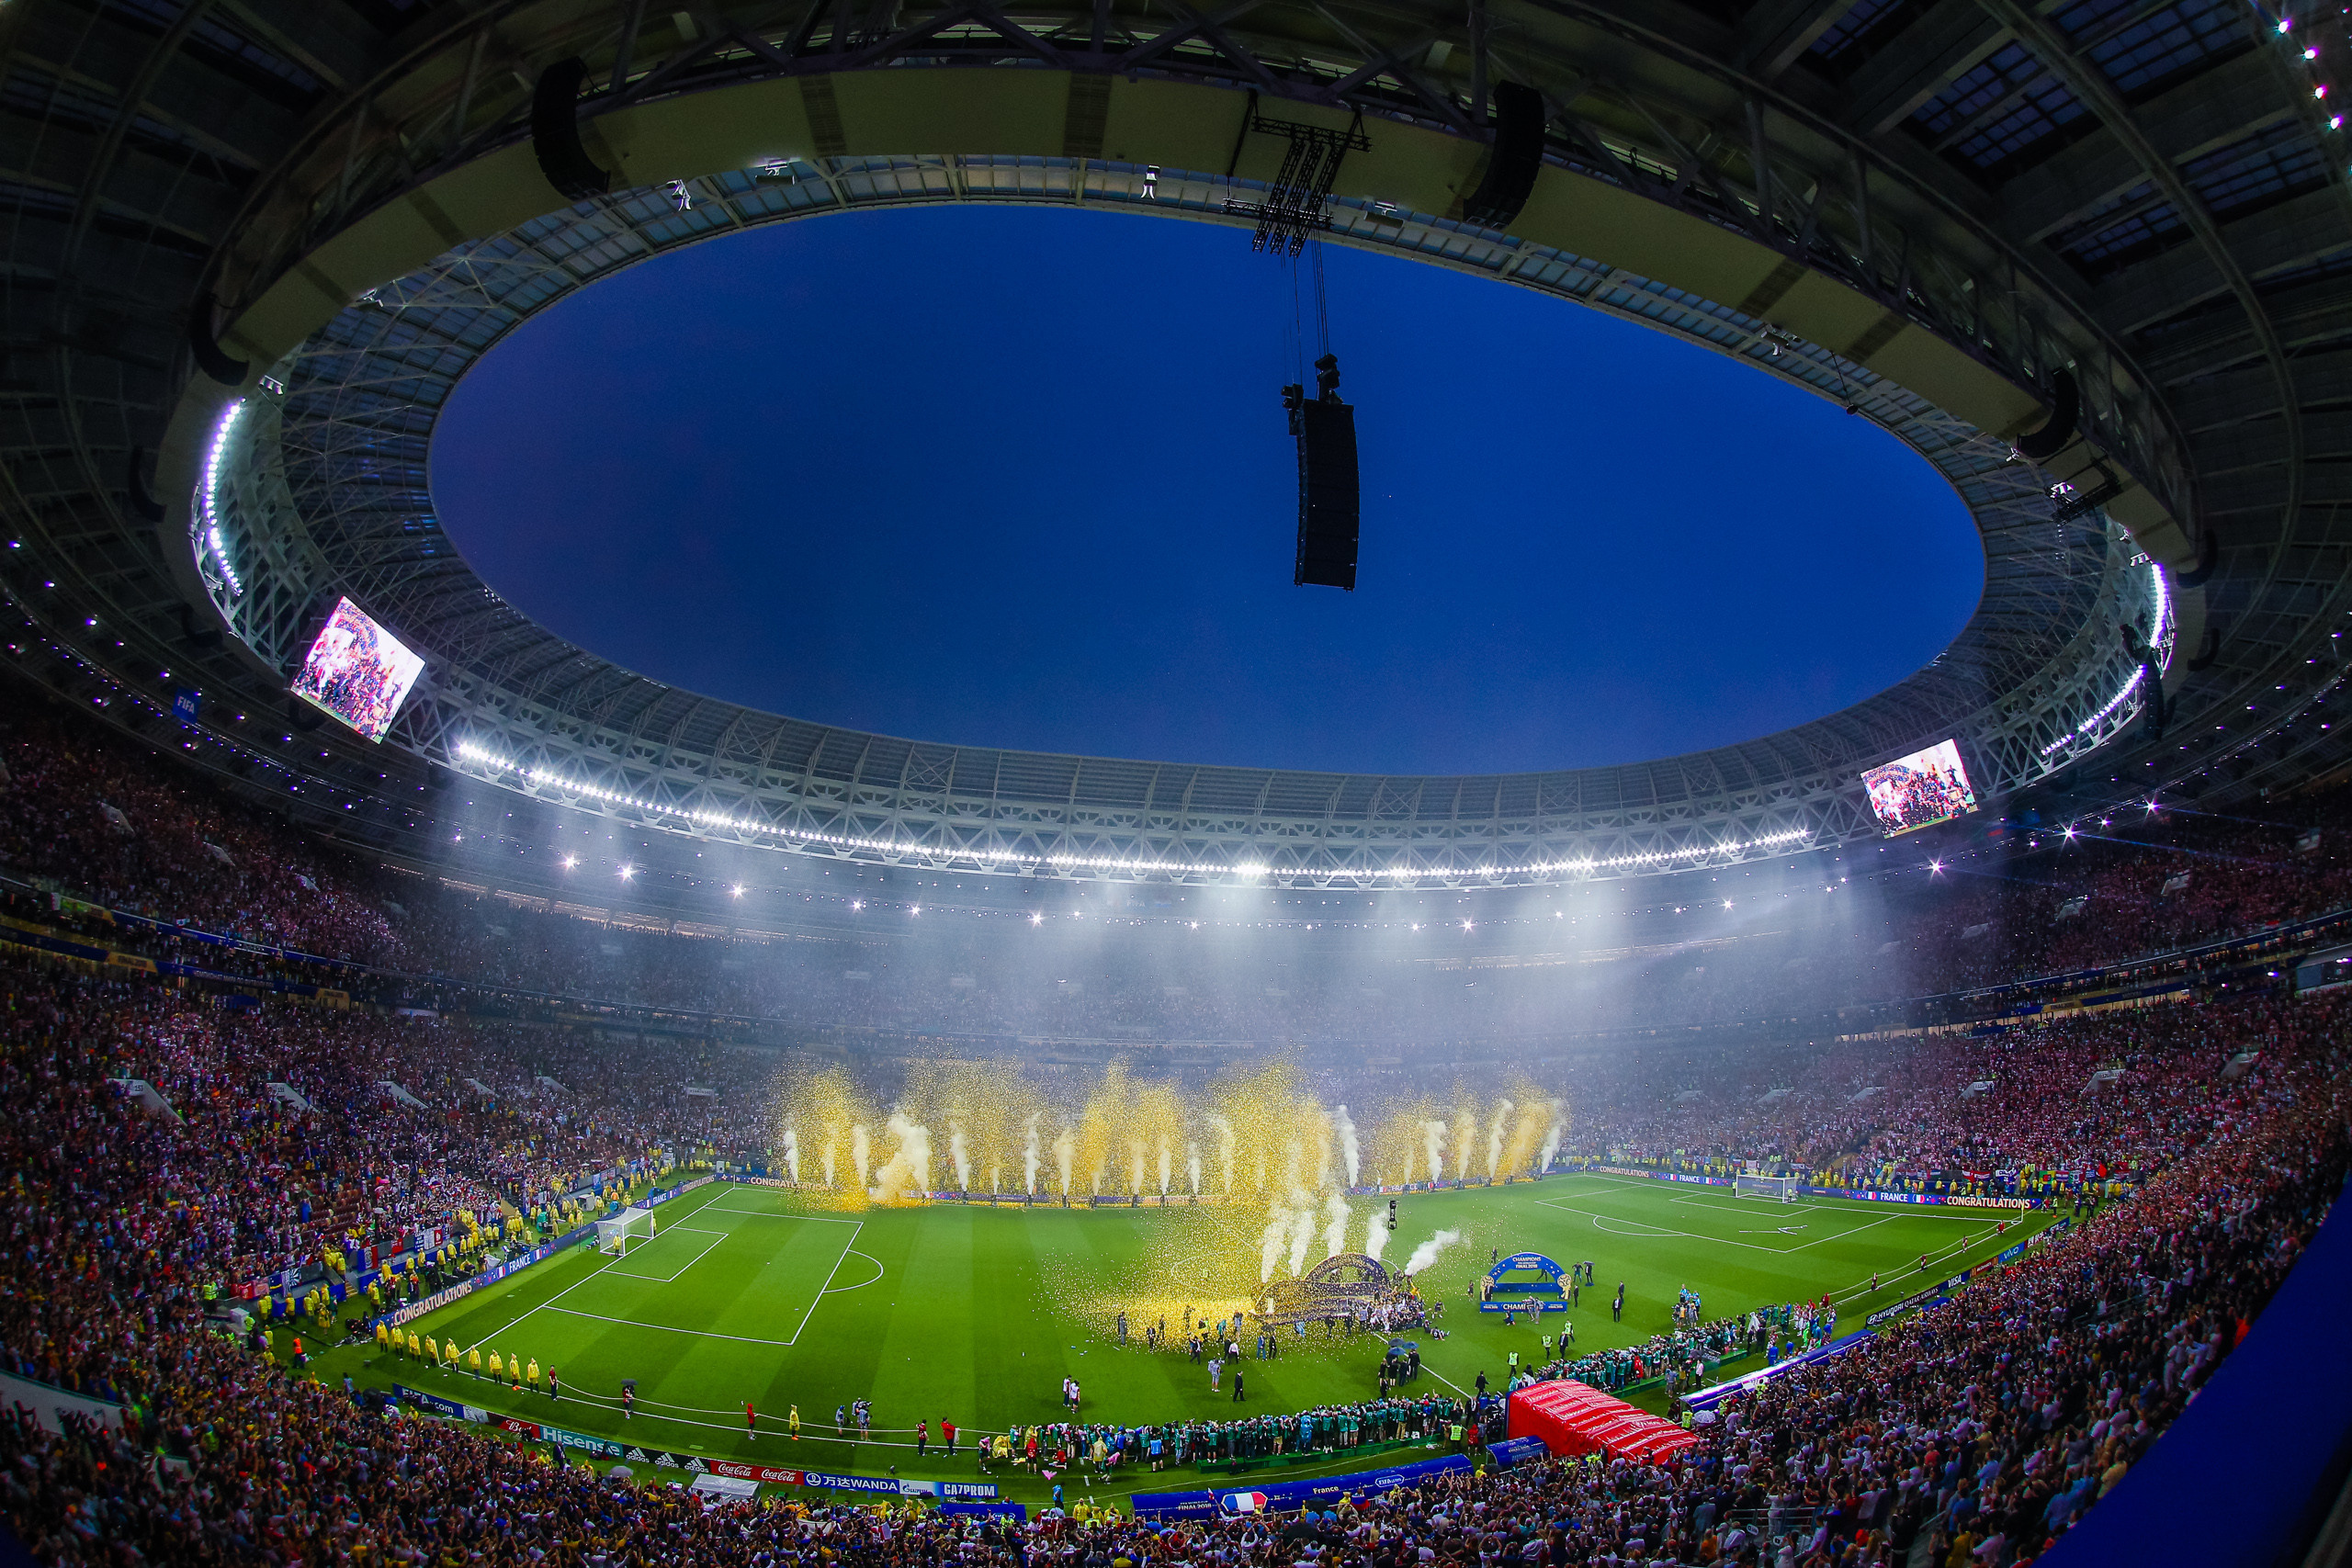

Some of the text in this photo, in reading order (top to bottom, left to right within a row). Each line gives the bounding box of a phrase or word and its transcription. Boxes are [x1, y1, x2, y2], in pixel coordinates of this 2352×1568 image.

[177, 696, 195, 715] FIFA
[1600, 1166, 1649, 1179] CONGRATULATIONS
[1679, 1174, 1700, 1183] FRANCE
[682, 1174, 715, 1193] CONGRATULATIONS
[652, 1192, 667, 1205] FRANCE
[1880, 1192, 1908, 1202] FRANCE
[1947, 1196, 2030, 1209] CONGRATULATIONS
[509, 1254, 531, 1273] FRANCE
[1948, 1274, 1962, 1288] VISA
[393, 1280, 472, 1325] CONGRATULATIONS
[1904, 1295, 1920, 1308] QATAR
[542, 1427, 620, 1456] Hisense
[626, 1454, 650, 1463] adidas
[654, 1459, 679, 1469] adidas
[684, 1464, 709, 1473] adidas
[1313, 1485, 1340, 1495] France
